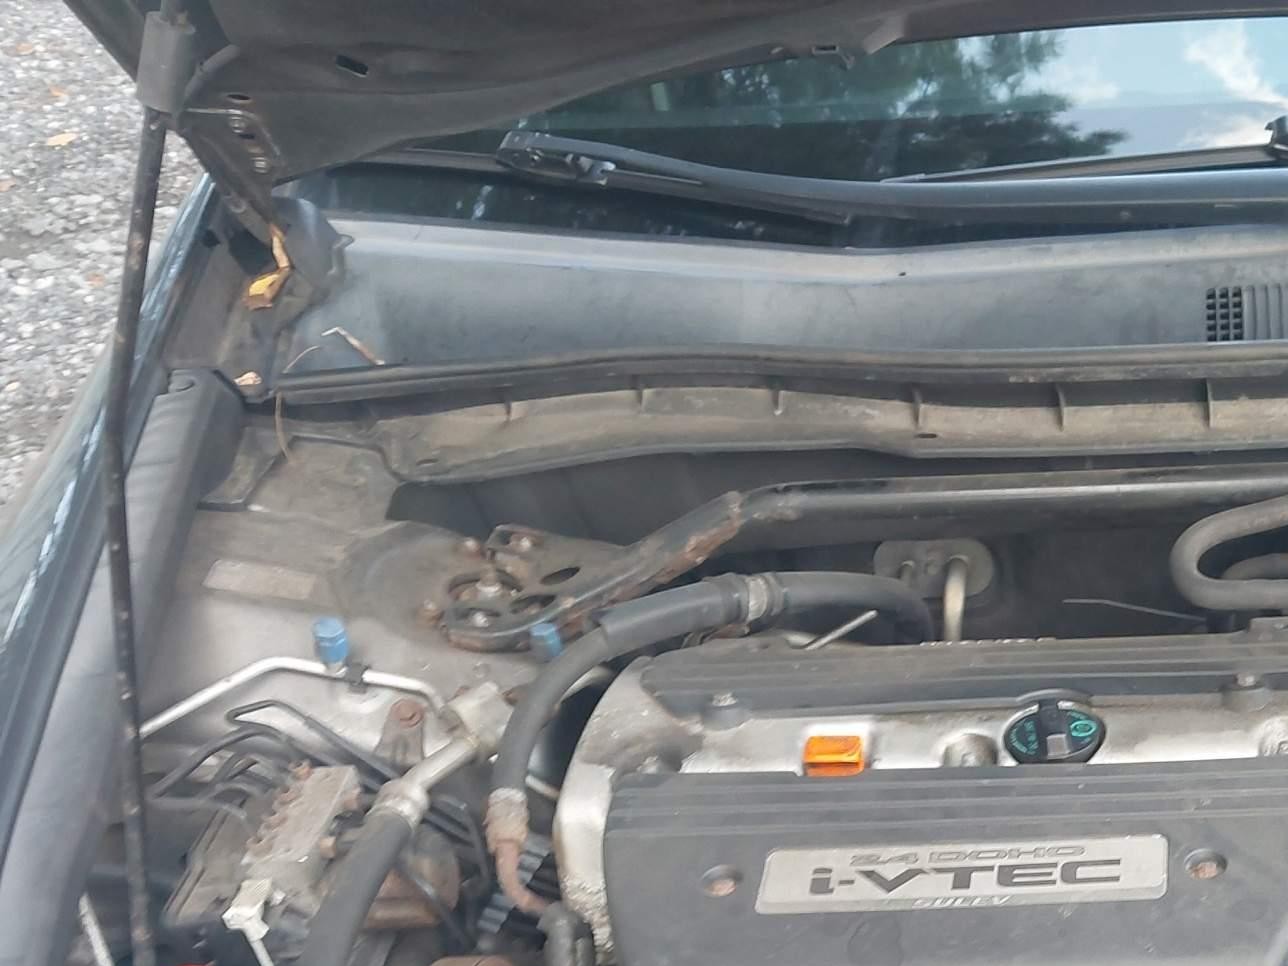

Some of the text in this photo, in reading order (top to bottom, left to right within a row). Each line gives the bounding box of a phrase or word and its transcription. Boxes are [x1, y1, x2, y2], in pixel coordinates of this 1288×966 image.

[849, 845, 1086, 867] 2.4 DOHC
[809, 858, 1121, 894] i-VTEC
